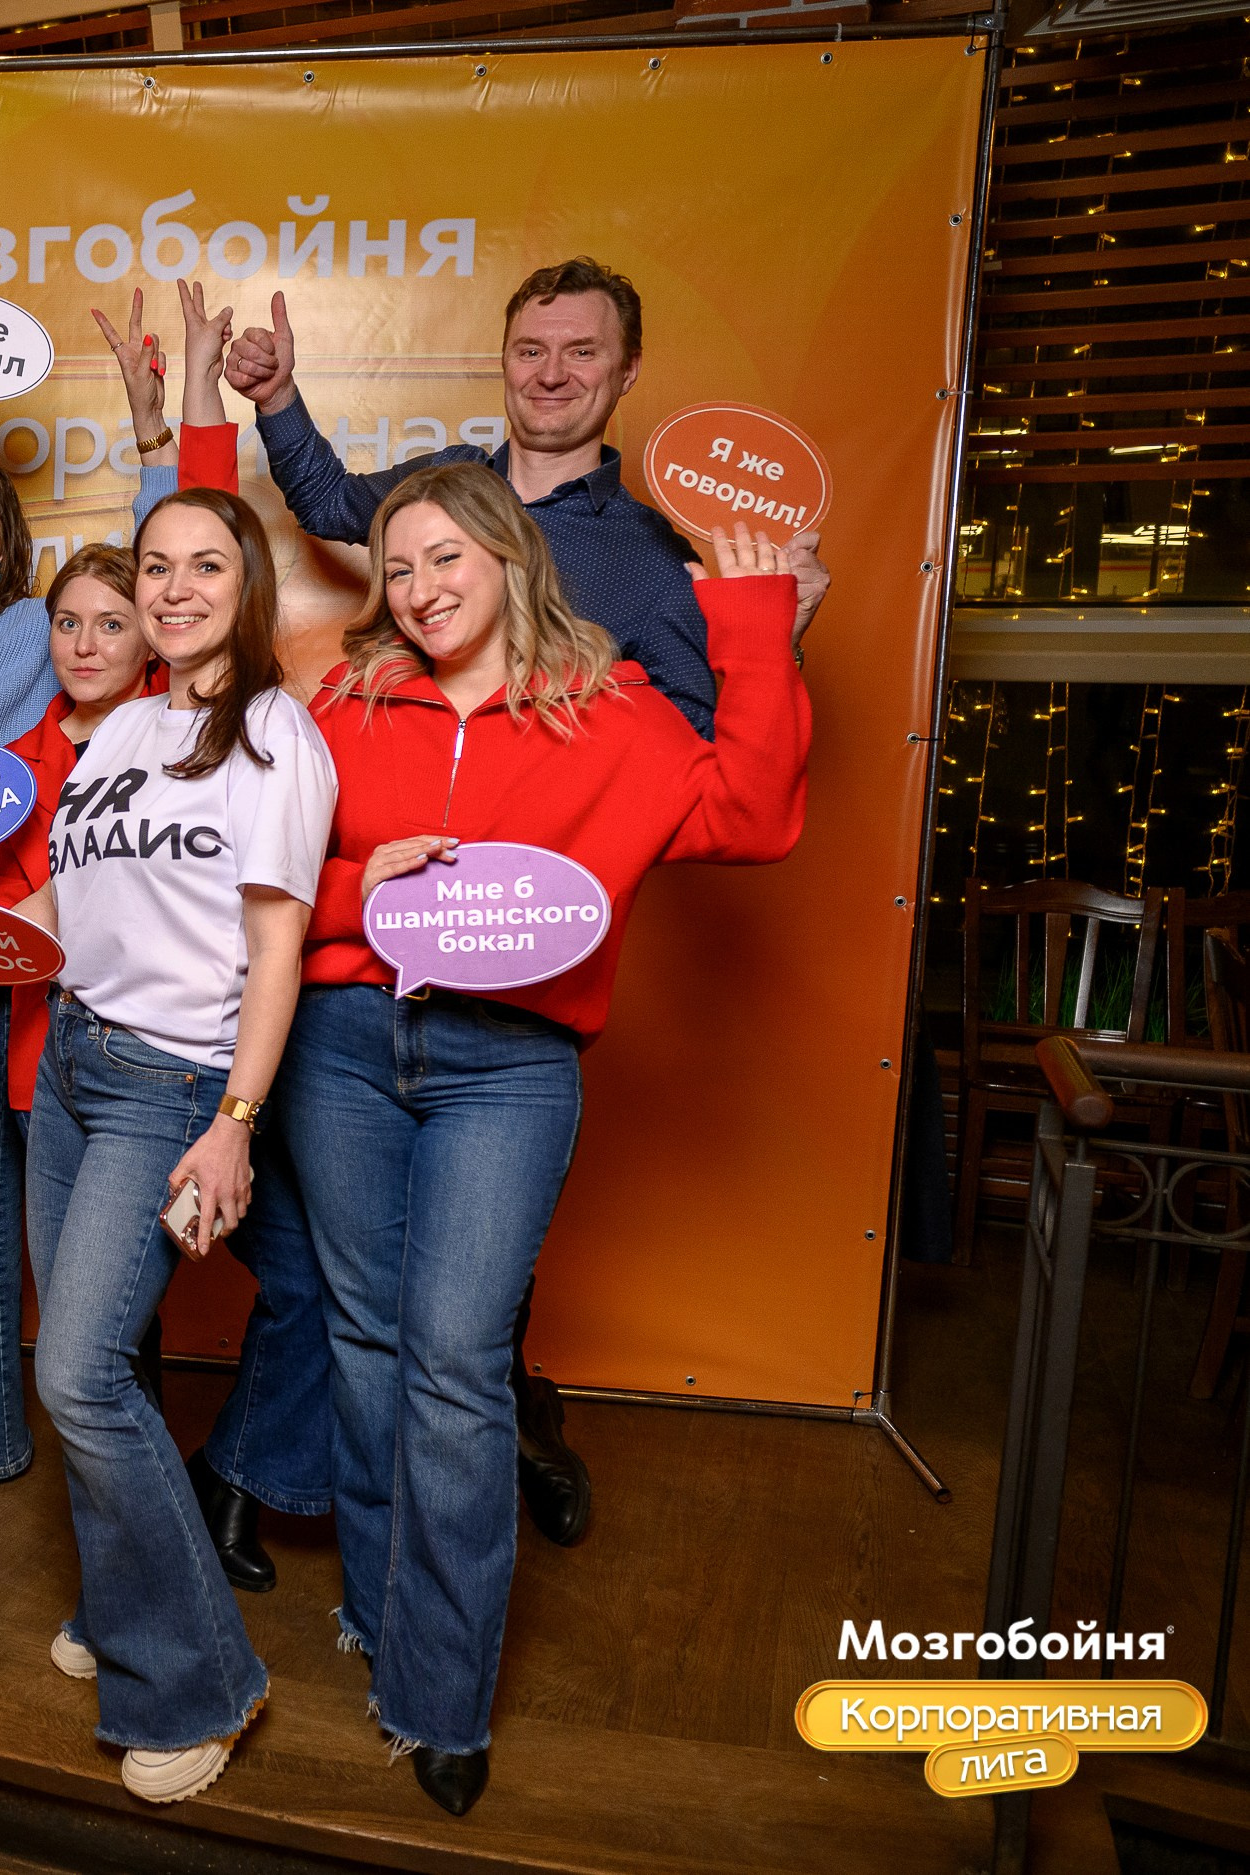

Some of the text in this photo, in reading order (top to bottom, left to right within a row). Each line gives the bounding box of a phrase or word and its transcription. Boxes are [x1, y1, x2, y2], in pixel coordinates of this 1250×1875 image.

[708, 437, 785, 481] Я же
[663, 462, 808, 529] говорил!
[48, 818, 223, 881] ВЛАДИС
[436, 875, 535, 902] Мне б
[375, 904, 600, 930] шампанского
[437, 929, 536, 953] бокал
